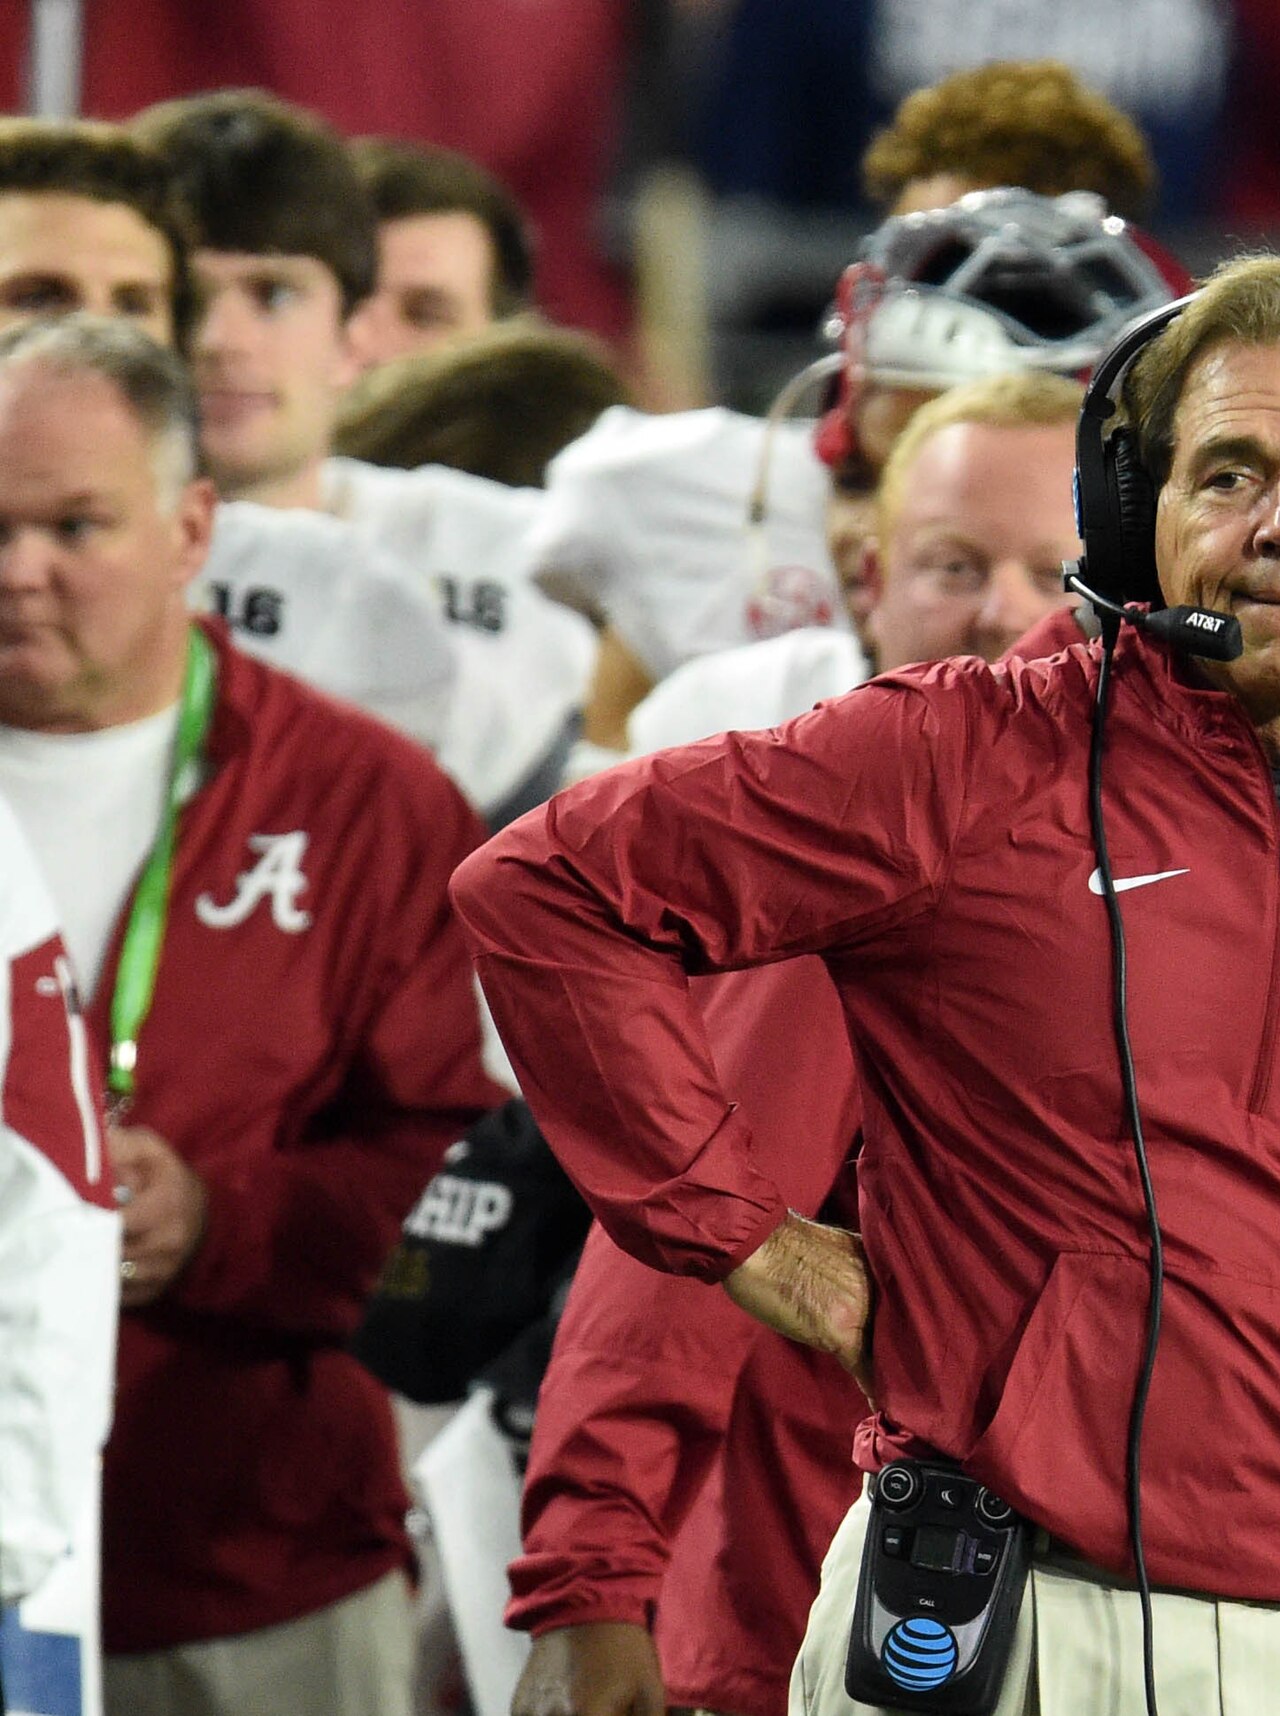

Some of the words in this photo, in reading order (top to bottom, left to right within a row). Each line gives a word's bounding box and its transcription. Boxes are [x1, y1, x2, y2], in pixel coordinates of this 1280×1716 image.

[1185, 612, 1226, 634] AT&T
[195, 830, 311, 933] A
[918, 1598, 935, 1607] CALL
